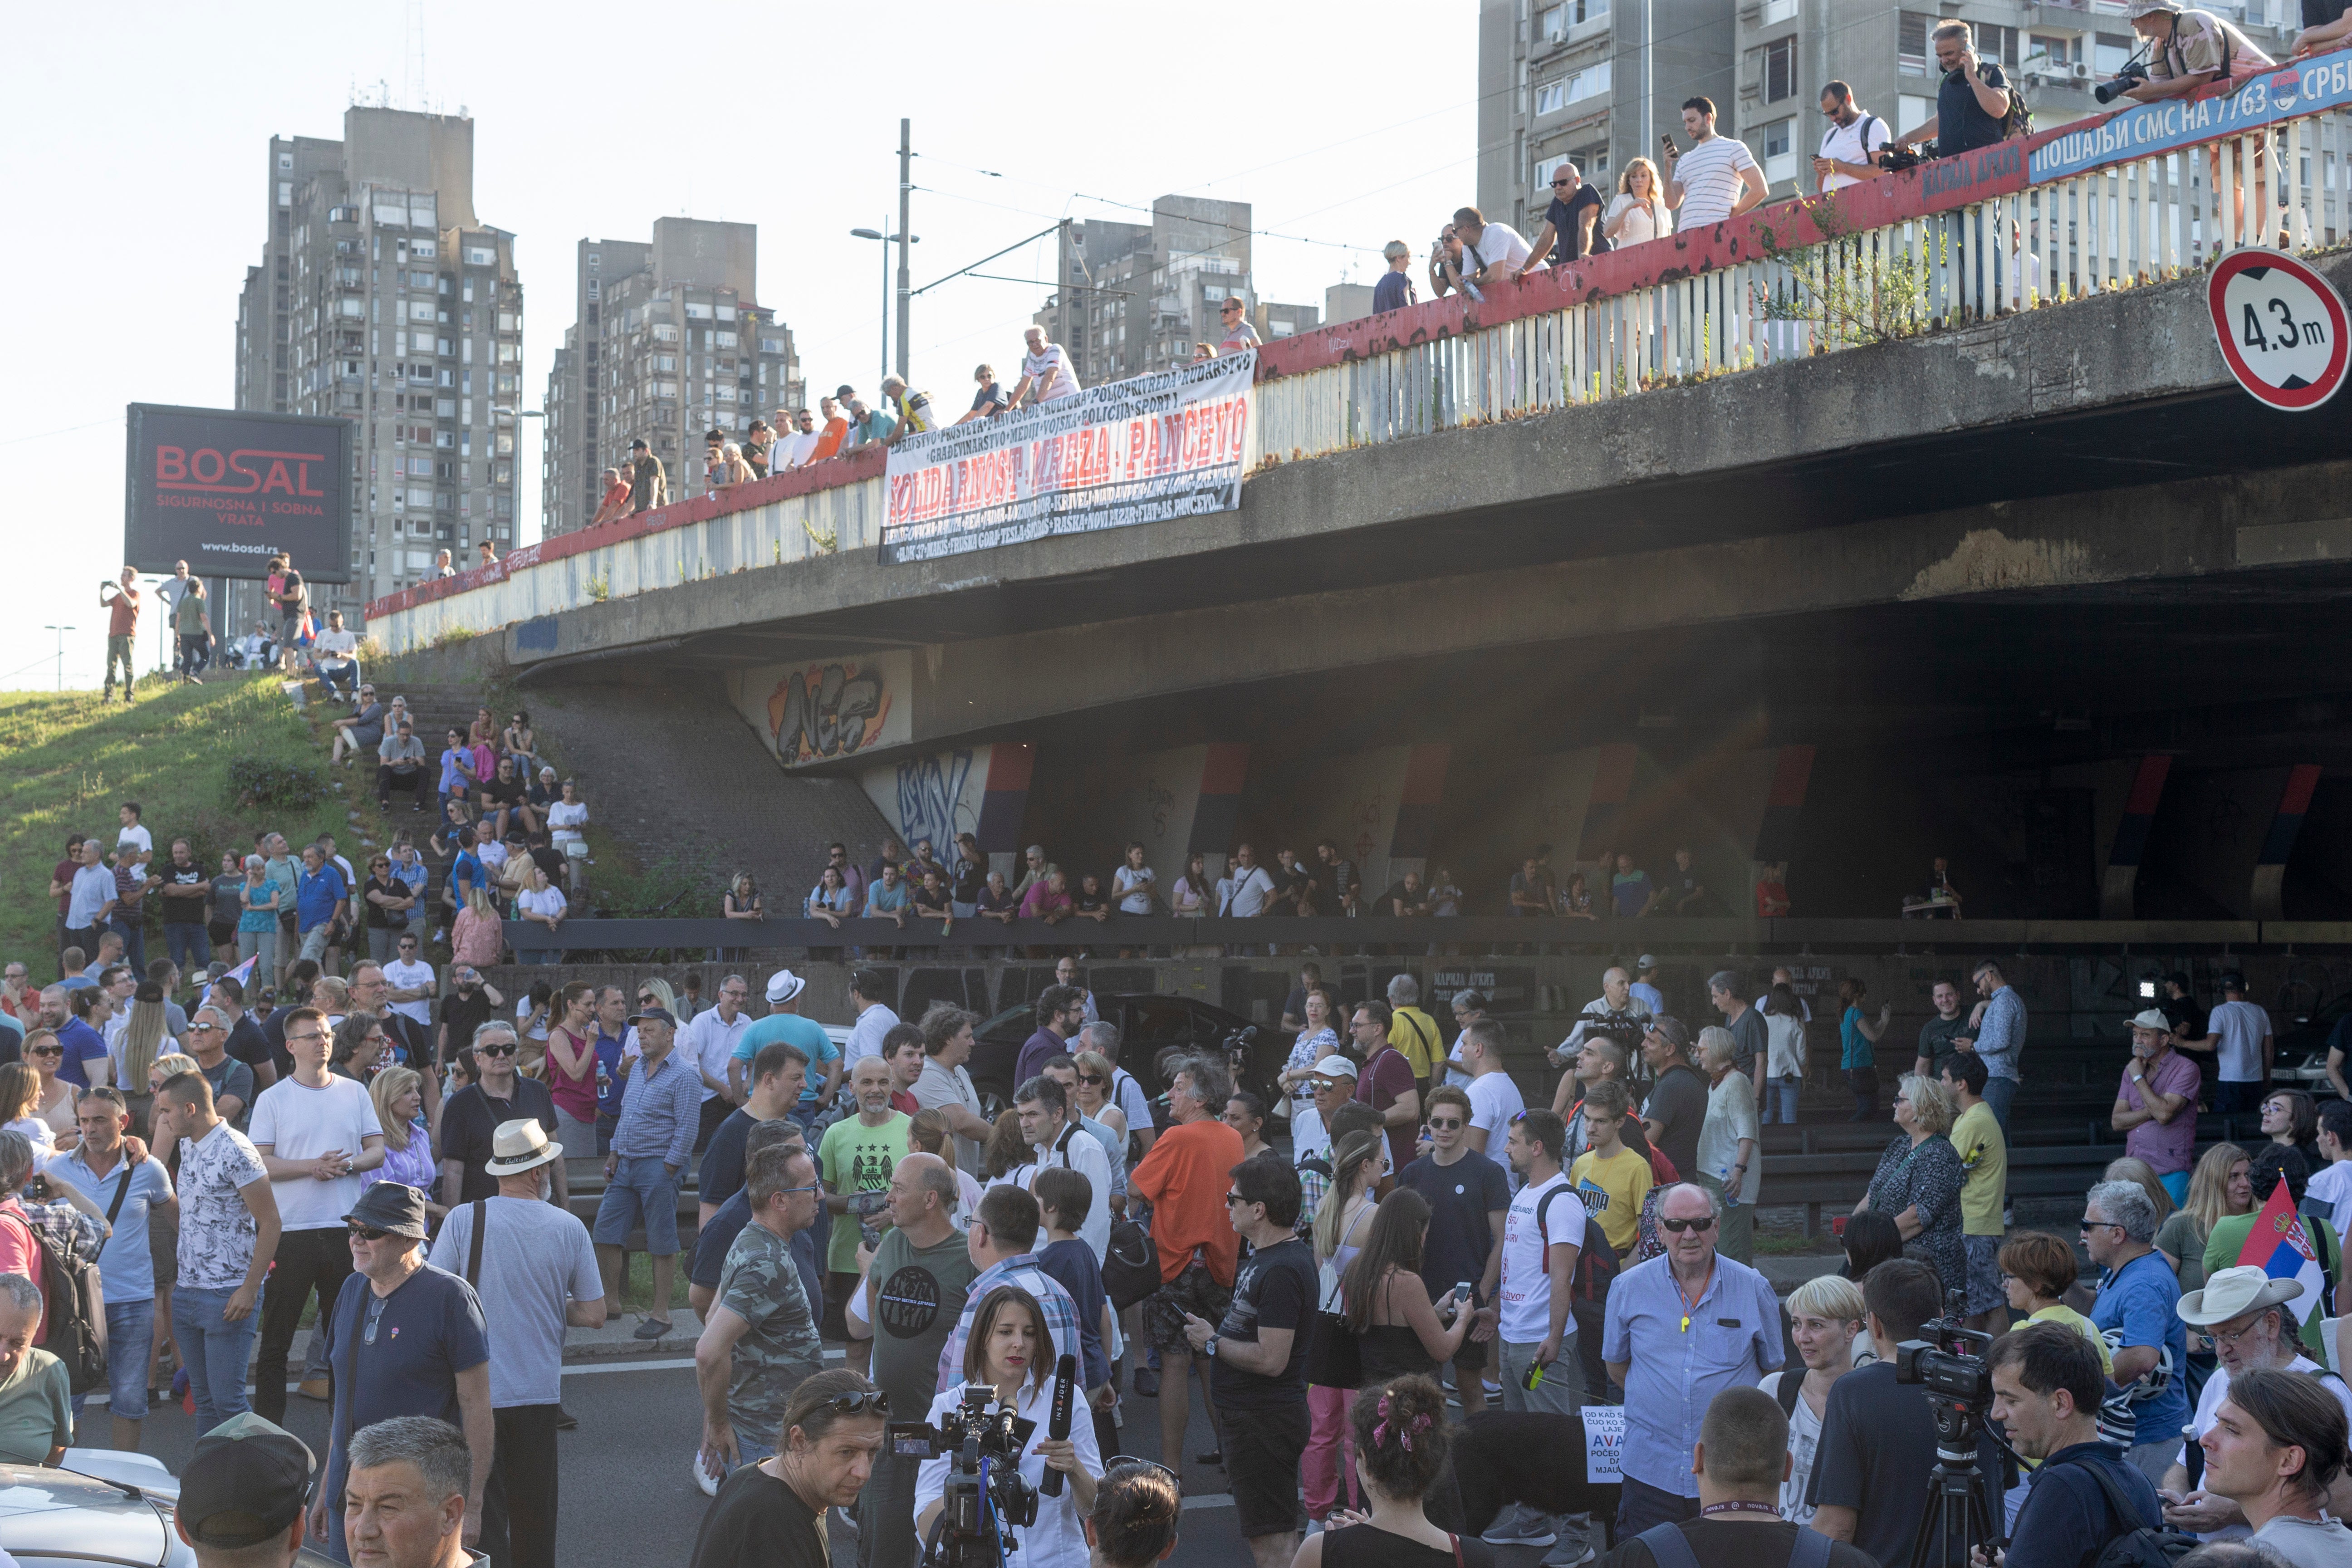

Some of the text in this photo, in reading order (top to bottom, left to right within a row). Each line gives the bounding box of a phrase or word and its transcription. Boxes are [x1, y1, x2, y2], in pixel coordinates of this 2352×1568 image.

[2035, 59, 2352, 172] ПОШАЉИ СМС НА 7763 СРБ
[1044, 391, 1087, 416] KULTURA
[1090, 371, 1177, 404] POLJOPRIVREDA
[1181, 353, 1251, 386] RUDARSTVO
[930, 431, 1005, 463] GRAĐEVINARSTVO
[1010, 422, 1039, 444] MEDIJI
[1044, 414, 1077, 435] VOJSKA
[1081, 402, 1131, 427] POLICIJA
[1135, 393, 1172, 416] SPORT
[1126, 397, 1247, 478] PANČEVO
[156, 445, 324, 497] BOSAL
[156, 495, 323, 516] SIGURNOSNA I SOBNA
[216, 513, 265, 527] VRATA
[1052, 511, 1086, 535] RAŠKA
[1087, 509, 1109, 530] NOVI
[1107, 505, 1137, 527] PAZAR
[201, 543, 279, 555] www.bosal.rs
[505, 1154, 530, 1165] Chalkidiki
[1505, 1290, 1526, 1301] ŽIVOT
[1591, 1449, 1620, 1457] POČEO
[1706, 1504, 1725, 1513] nova.rs
